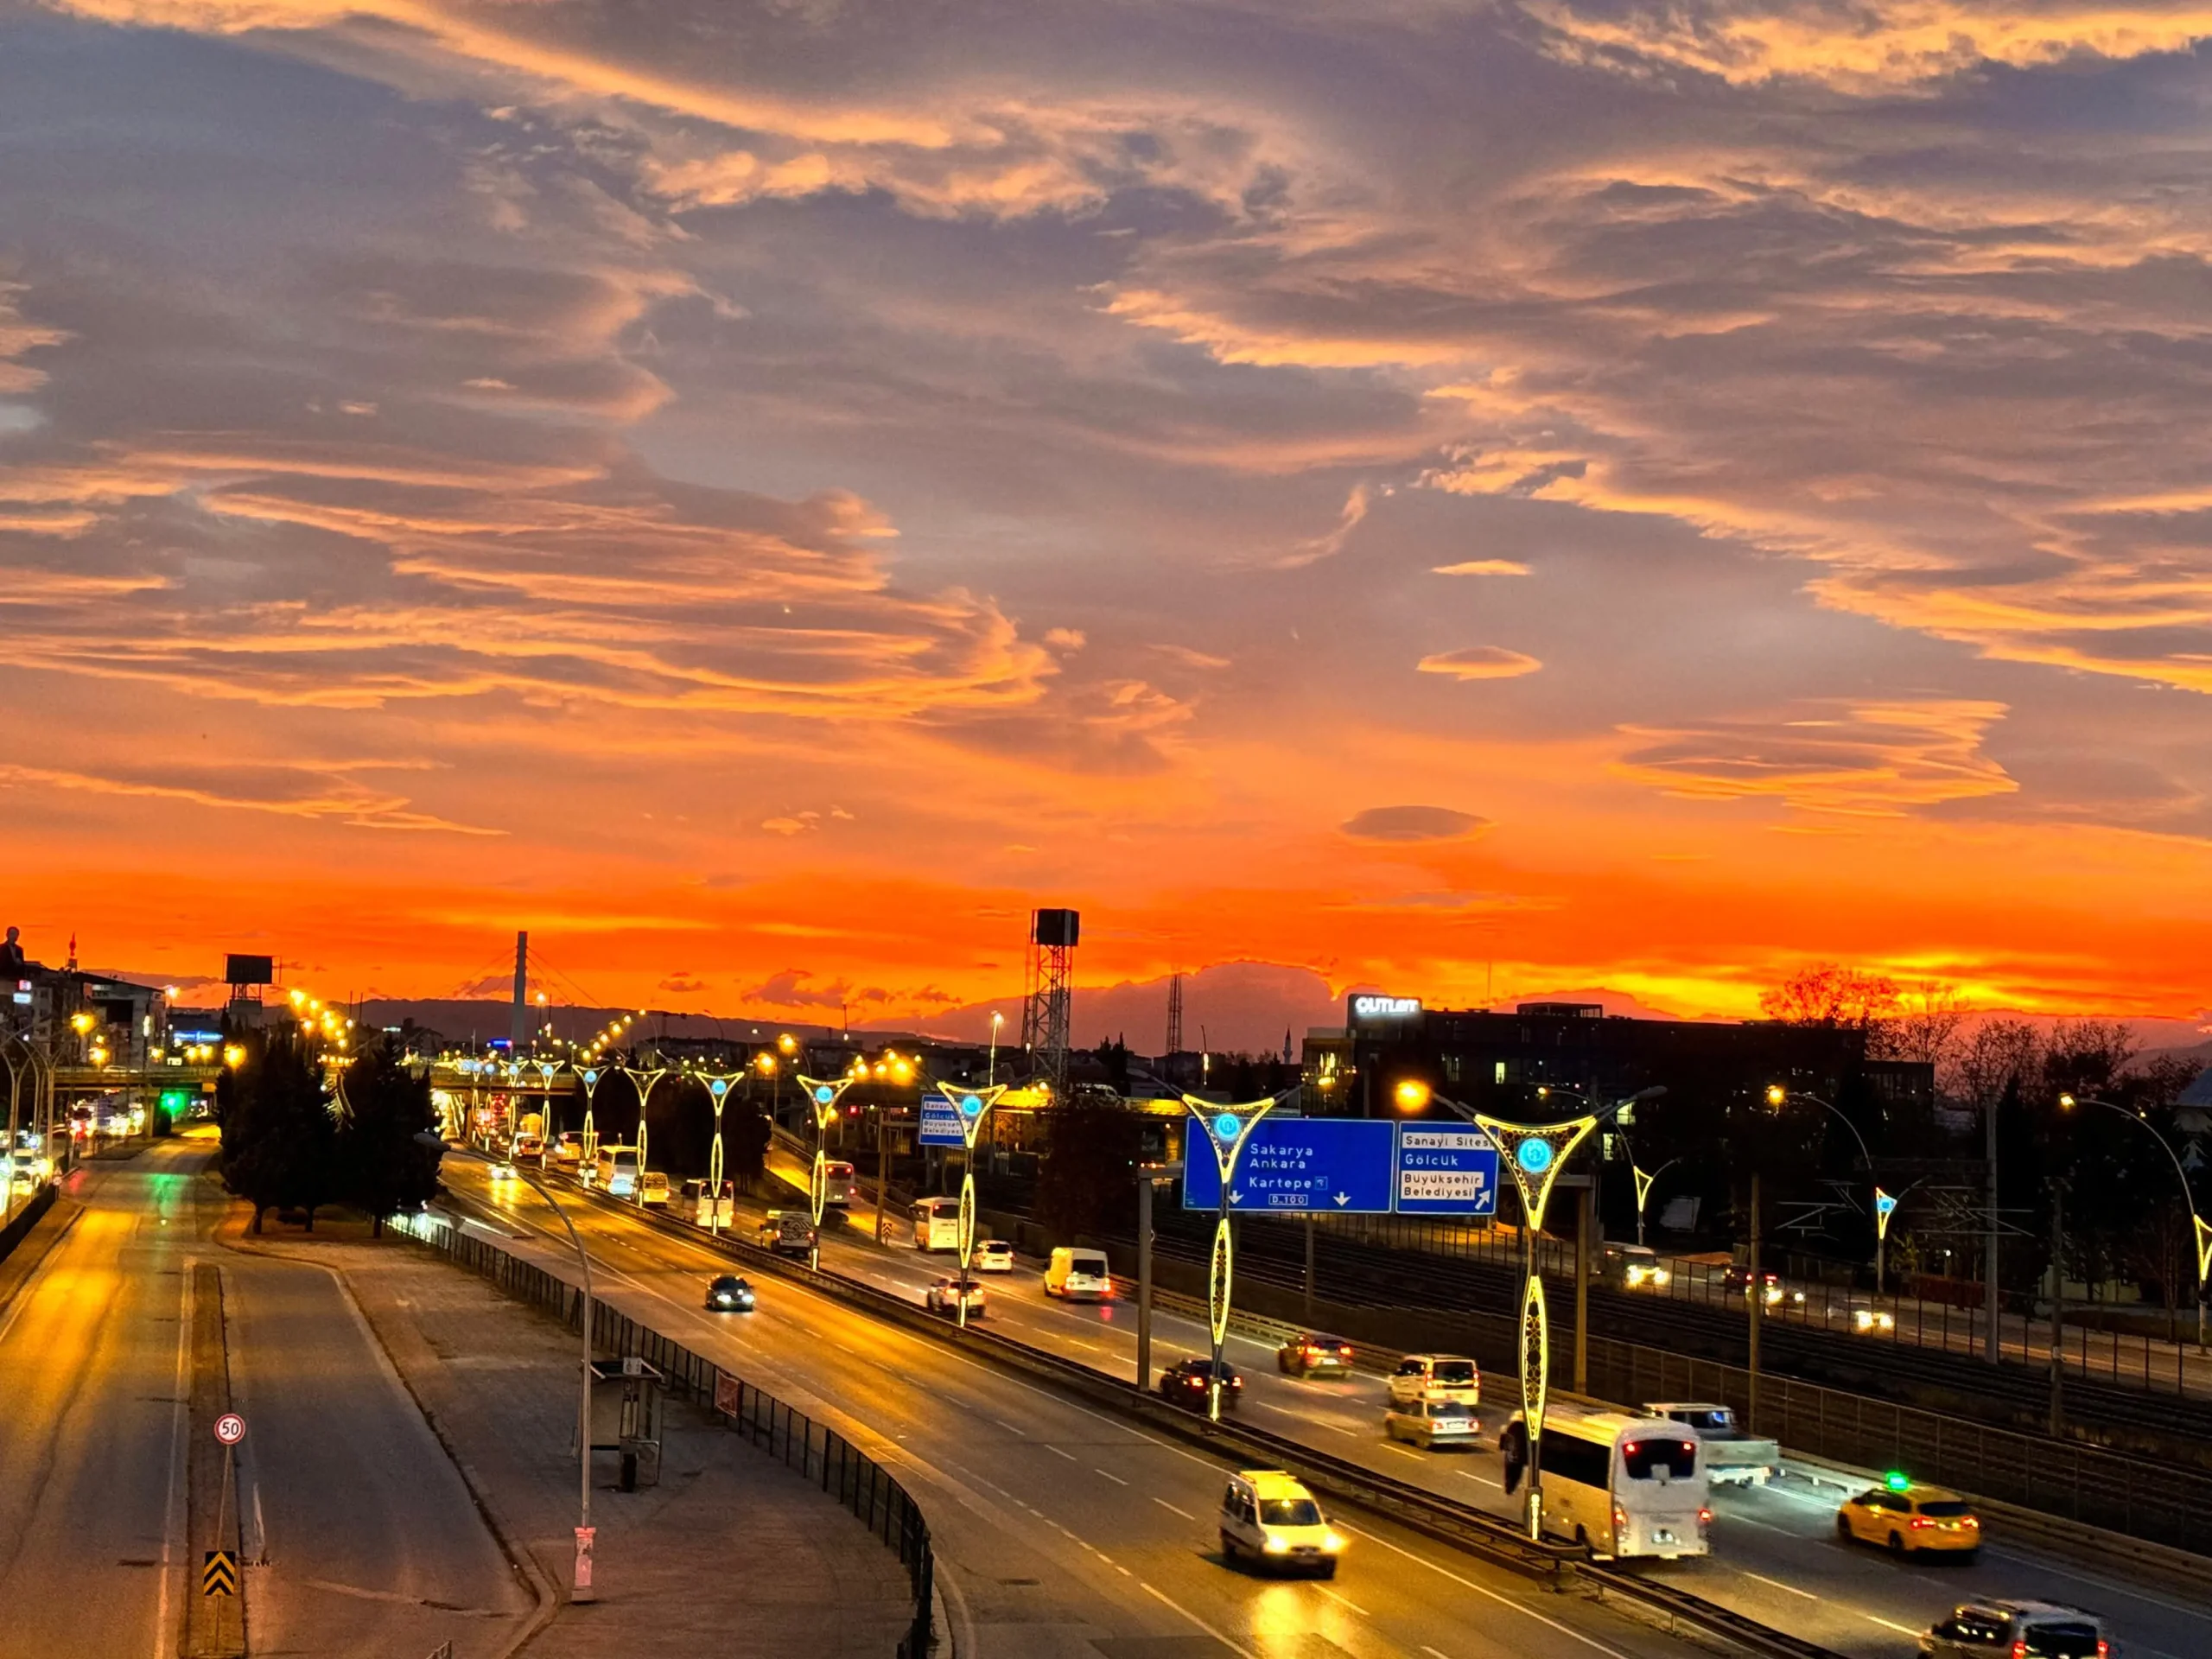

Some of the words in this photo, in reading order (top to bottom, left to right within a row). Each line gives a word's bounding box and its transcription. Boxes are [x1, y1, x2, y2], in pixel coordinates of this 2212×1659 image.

[1406, 1135, 1448, 1147] Sanayi
[1250, 1143, 1313, 1159] Sakarya
[1249, 1158, 1306, 1169] Ankara
[1249, 1176, 1312, 1192] Kartepe
[1404, 1186, 1472, 1198] Belediyesi
[222, 1421, 239, 1435] 50
